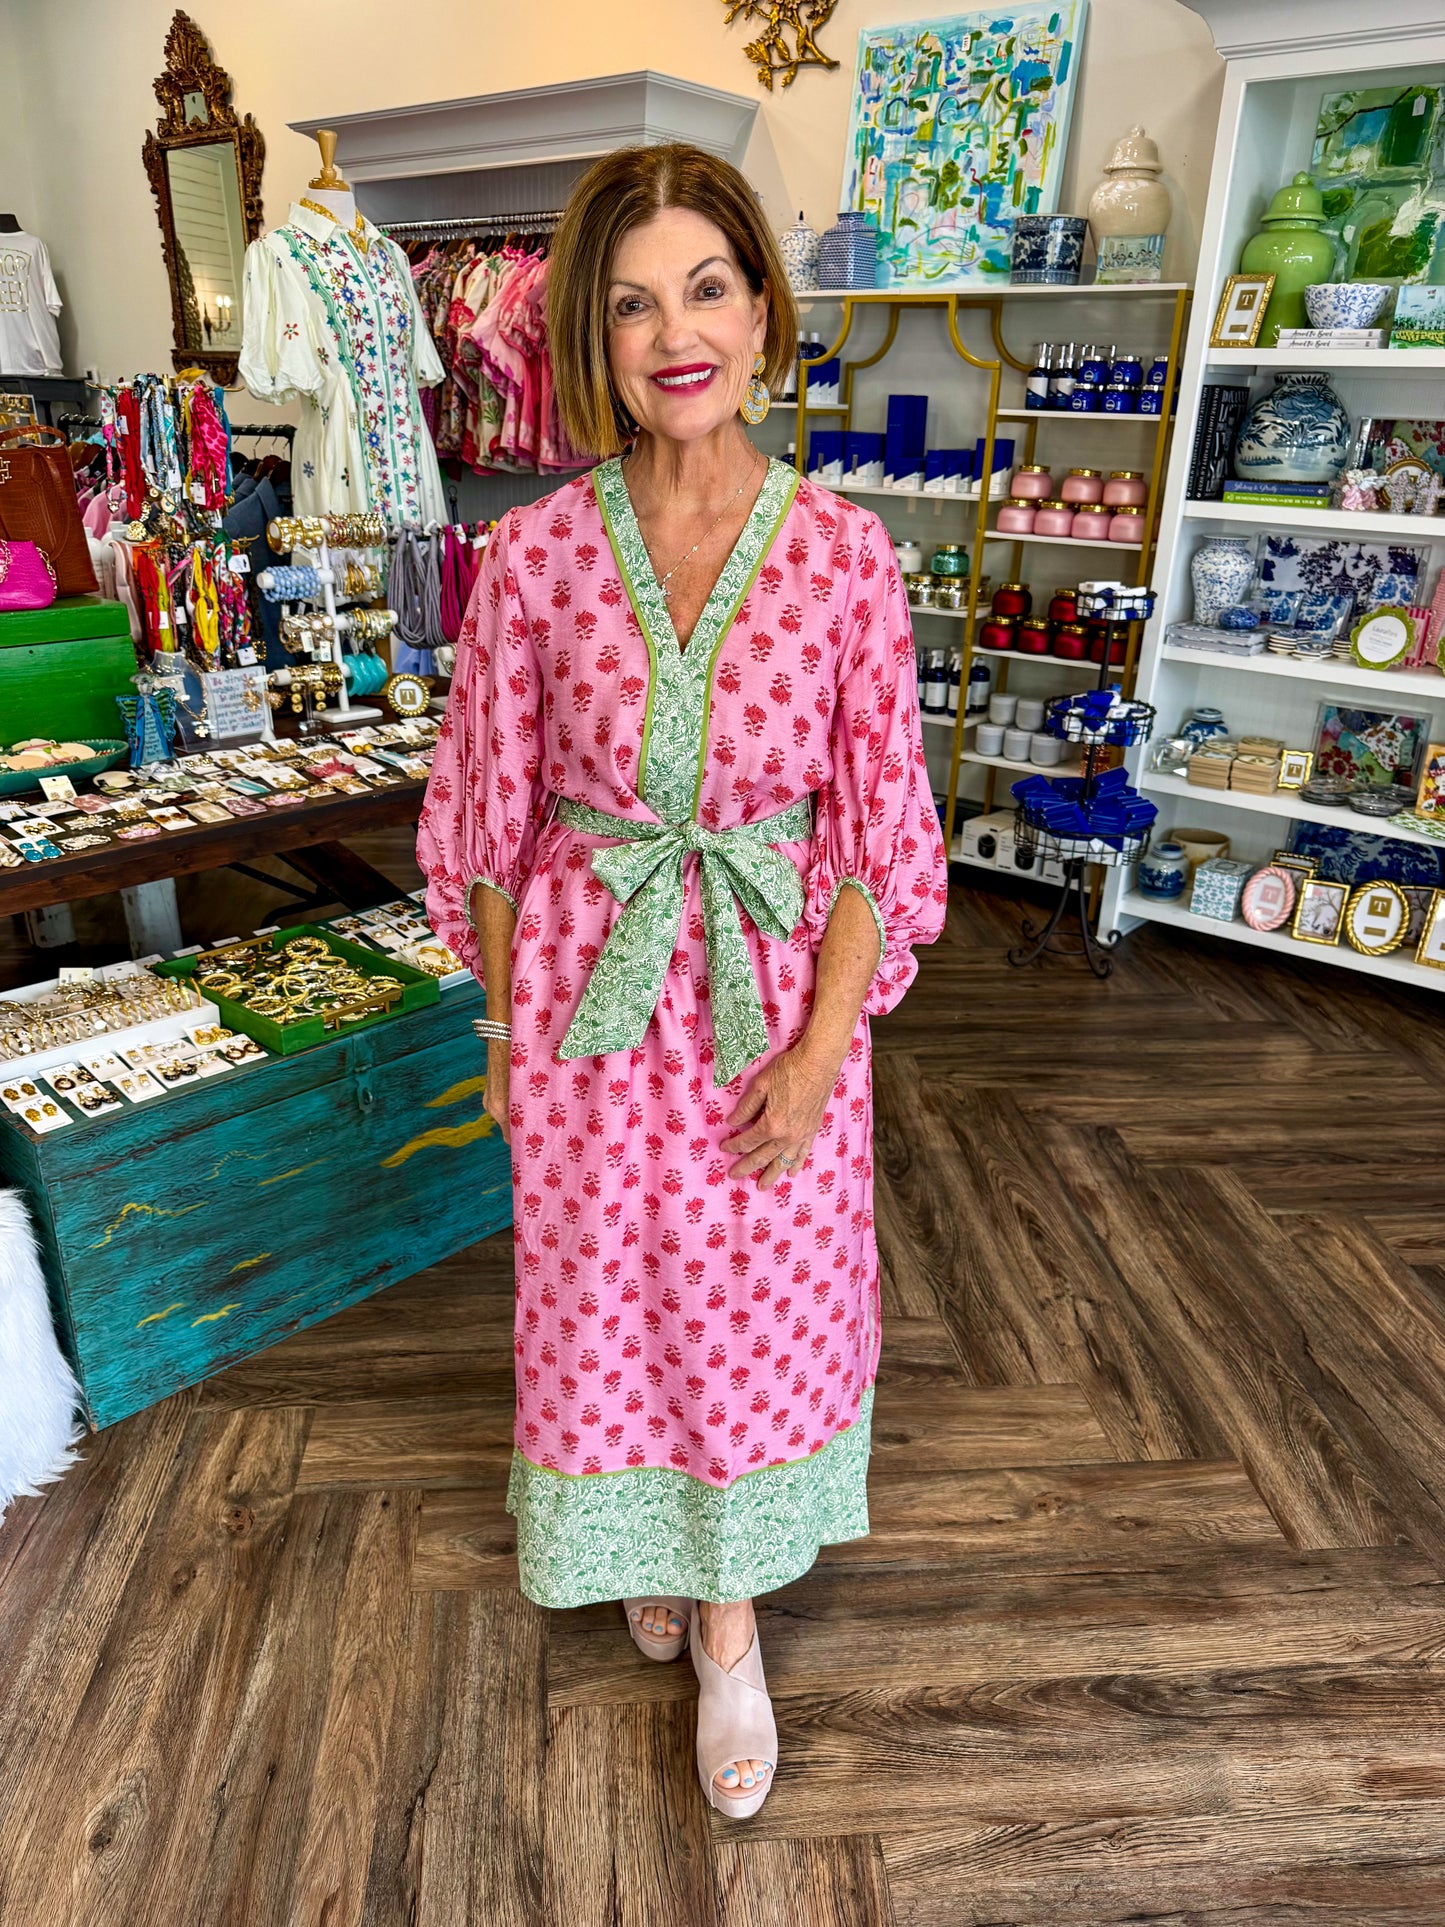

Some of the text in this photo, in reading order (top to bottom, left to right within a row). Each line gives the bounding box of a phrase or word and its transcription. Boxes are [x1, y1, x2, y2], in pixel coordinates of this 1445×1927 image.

[1242, 294, 1253, 306] T
[402, 690, 413, 701] T
[1290, 764, 1301, 775] T
[1374, 899, 1387, 913] T
